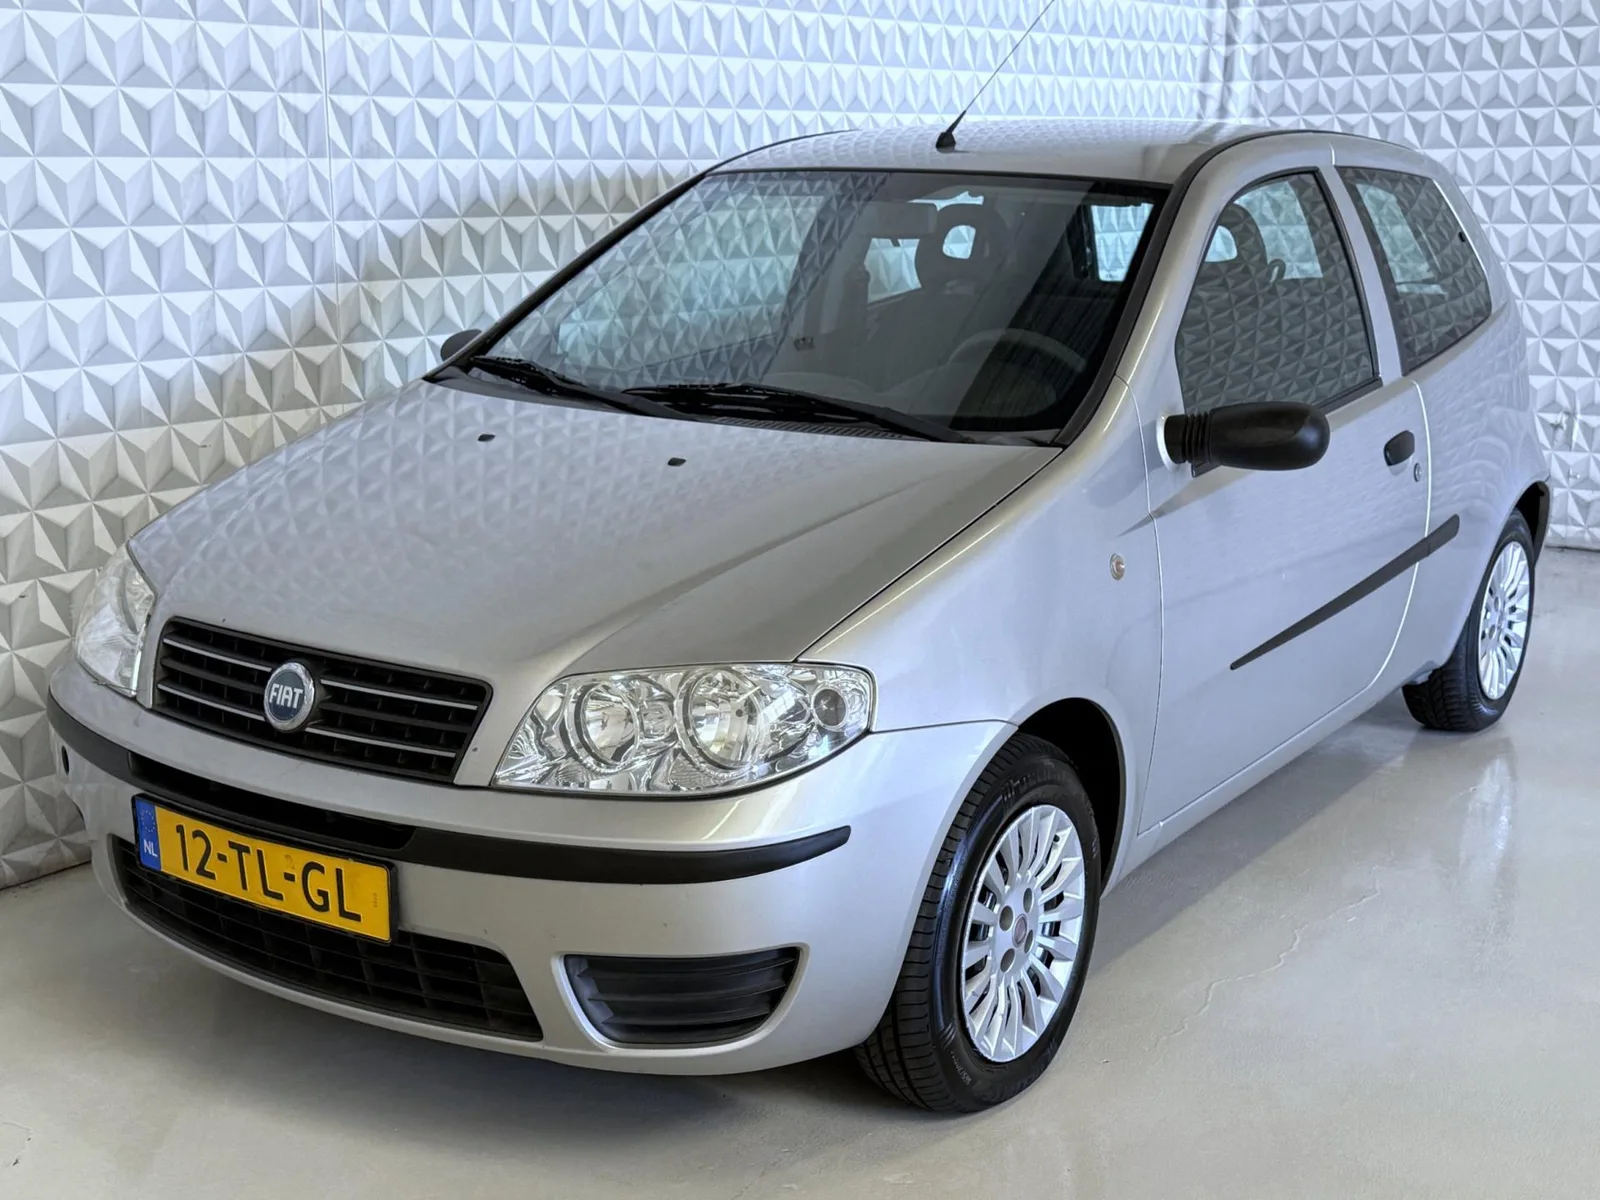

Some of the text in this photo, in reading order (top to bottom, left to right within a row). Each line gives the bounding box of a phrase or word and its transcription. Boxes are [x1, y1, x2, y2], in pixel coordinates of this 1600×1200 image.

[269, 683, 303, 709] FIAT
[143, 839, 158, 857] NL
[175, 823, 362, 922] 12-TL-GL
